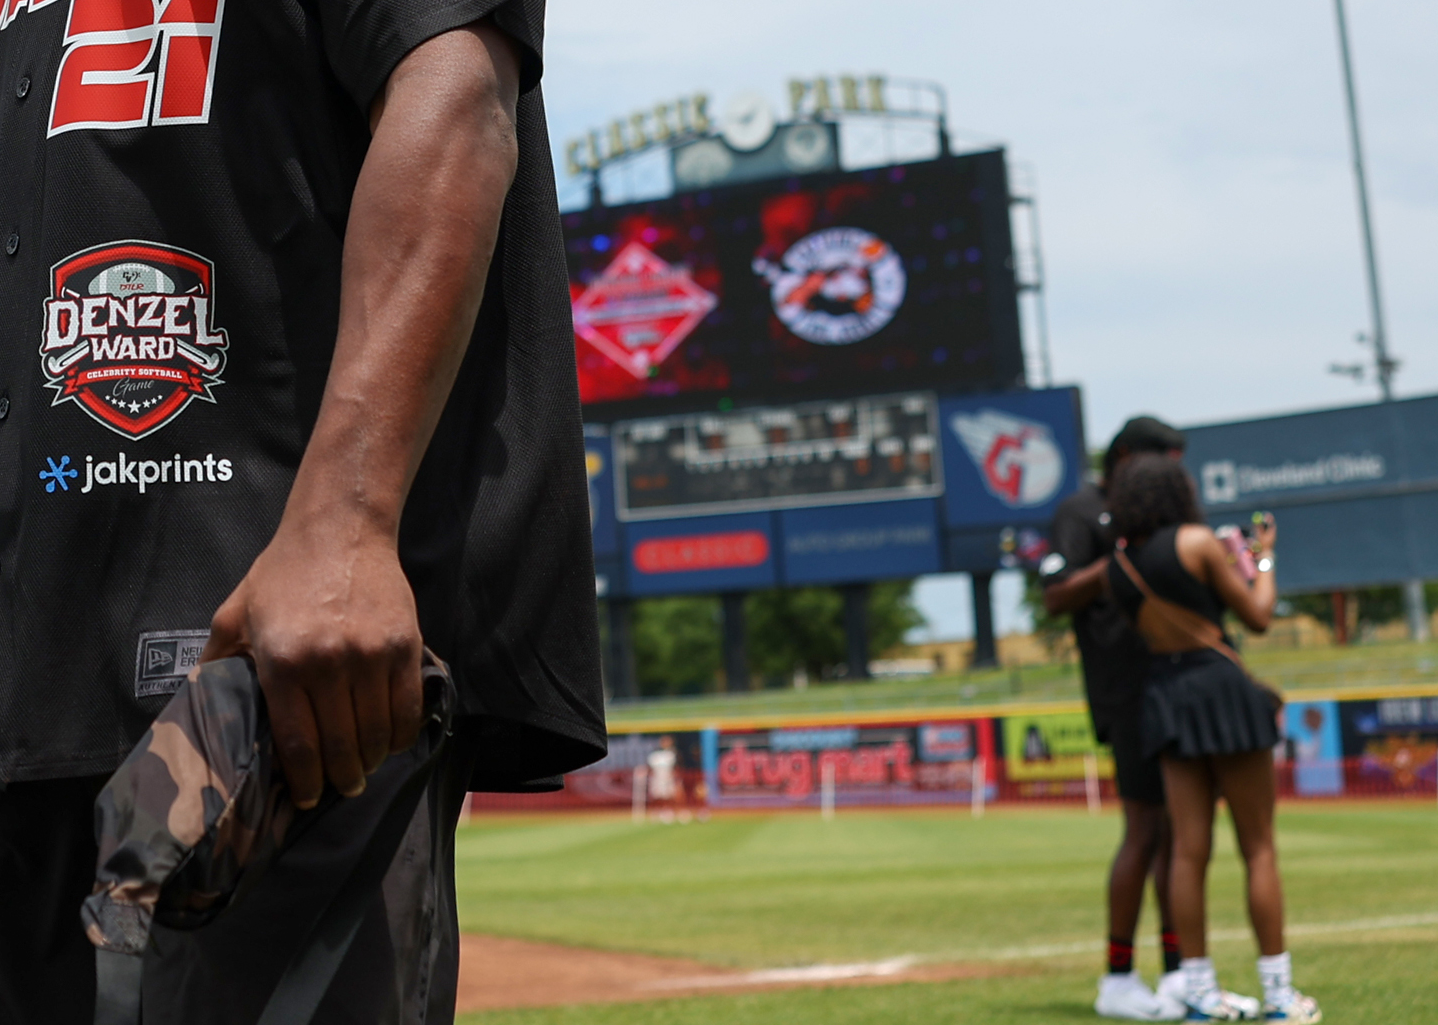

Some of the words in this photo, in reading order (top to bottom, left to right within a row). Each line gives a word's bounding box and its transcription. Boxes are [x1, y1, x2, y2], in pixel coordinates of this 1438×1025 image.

[565, 91, 711, 174] CLASSIC
[788, 76, 889, 112] PARK
[44, 295, 225, 351] DENZEL
[90, 333, 176, 362] WARD
[86, 368, 136, 379] CELEBRITY
[138, 368, 183, 379] SOFTBALL
[112, 376, 155, 399] Game
[80, 452, 234, 494] jakprints
[720, 739, 814, 800] drug
[818, 735, 914, 786] mart
